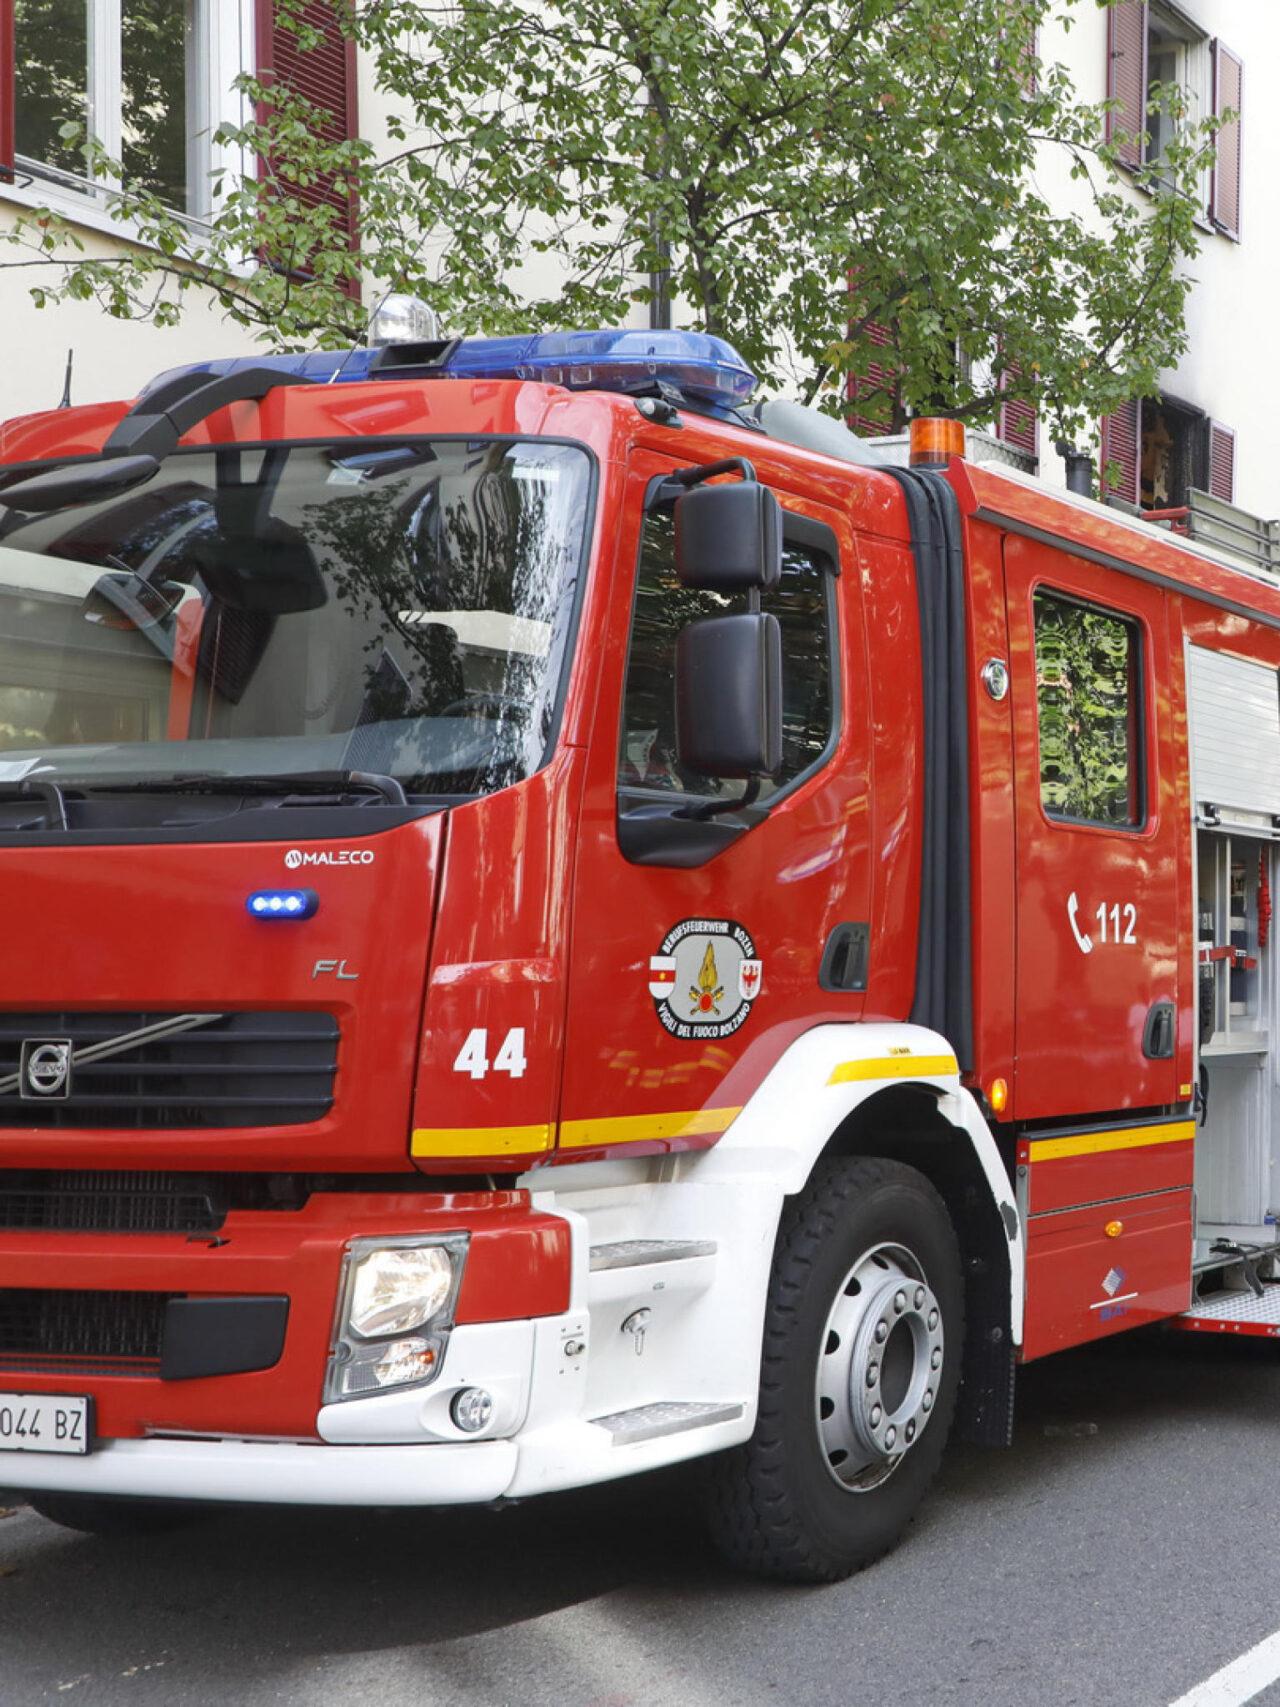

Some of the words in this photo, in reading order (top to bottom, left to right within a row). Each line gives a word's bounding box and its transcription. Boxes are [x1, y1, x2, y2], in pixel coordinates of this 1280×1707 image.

[303, 850, 374, 865] MALECO
[1096, 902, 1137, 944] 112
[734, 927, 755, 957] BOZEN
[312, 959, 359, 979] FL
[658, 1003, 678, 1033] VIGILI
[677, 1025, 691, 1037] DEL
[693, 1025, 719, 1037] FUOCO
[719, 1002, 750, 1036] BOLZANO
[452, 1027, 528, 1080] 44
[0, 1407, 41, 1437] 044
[55, 1409, 82, 1440] BZ
